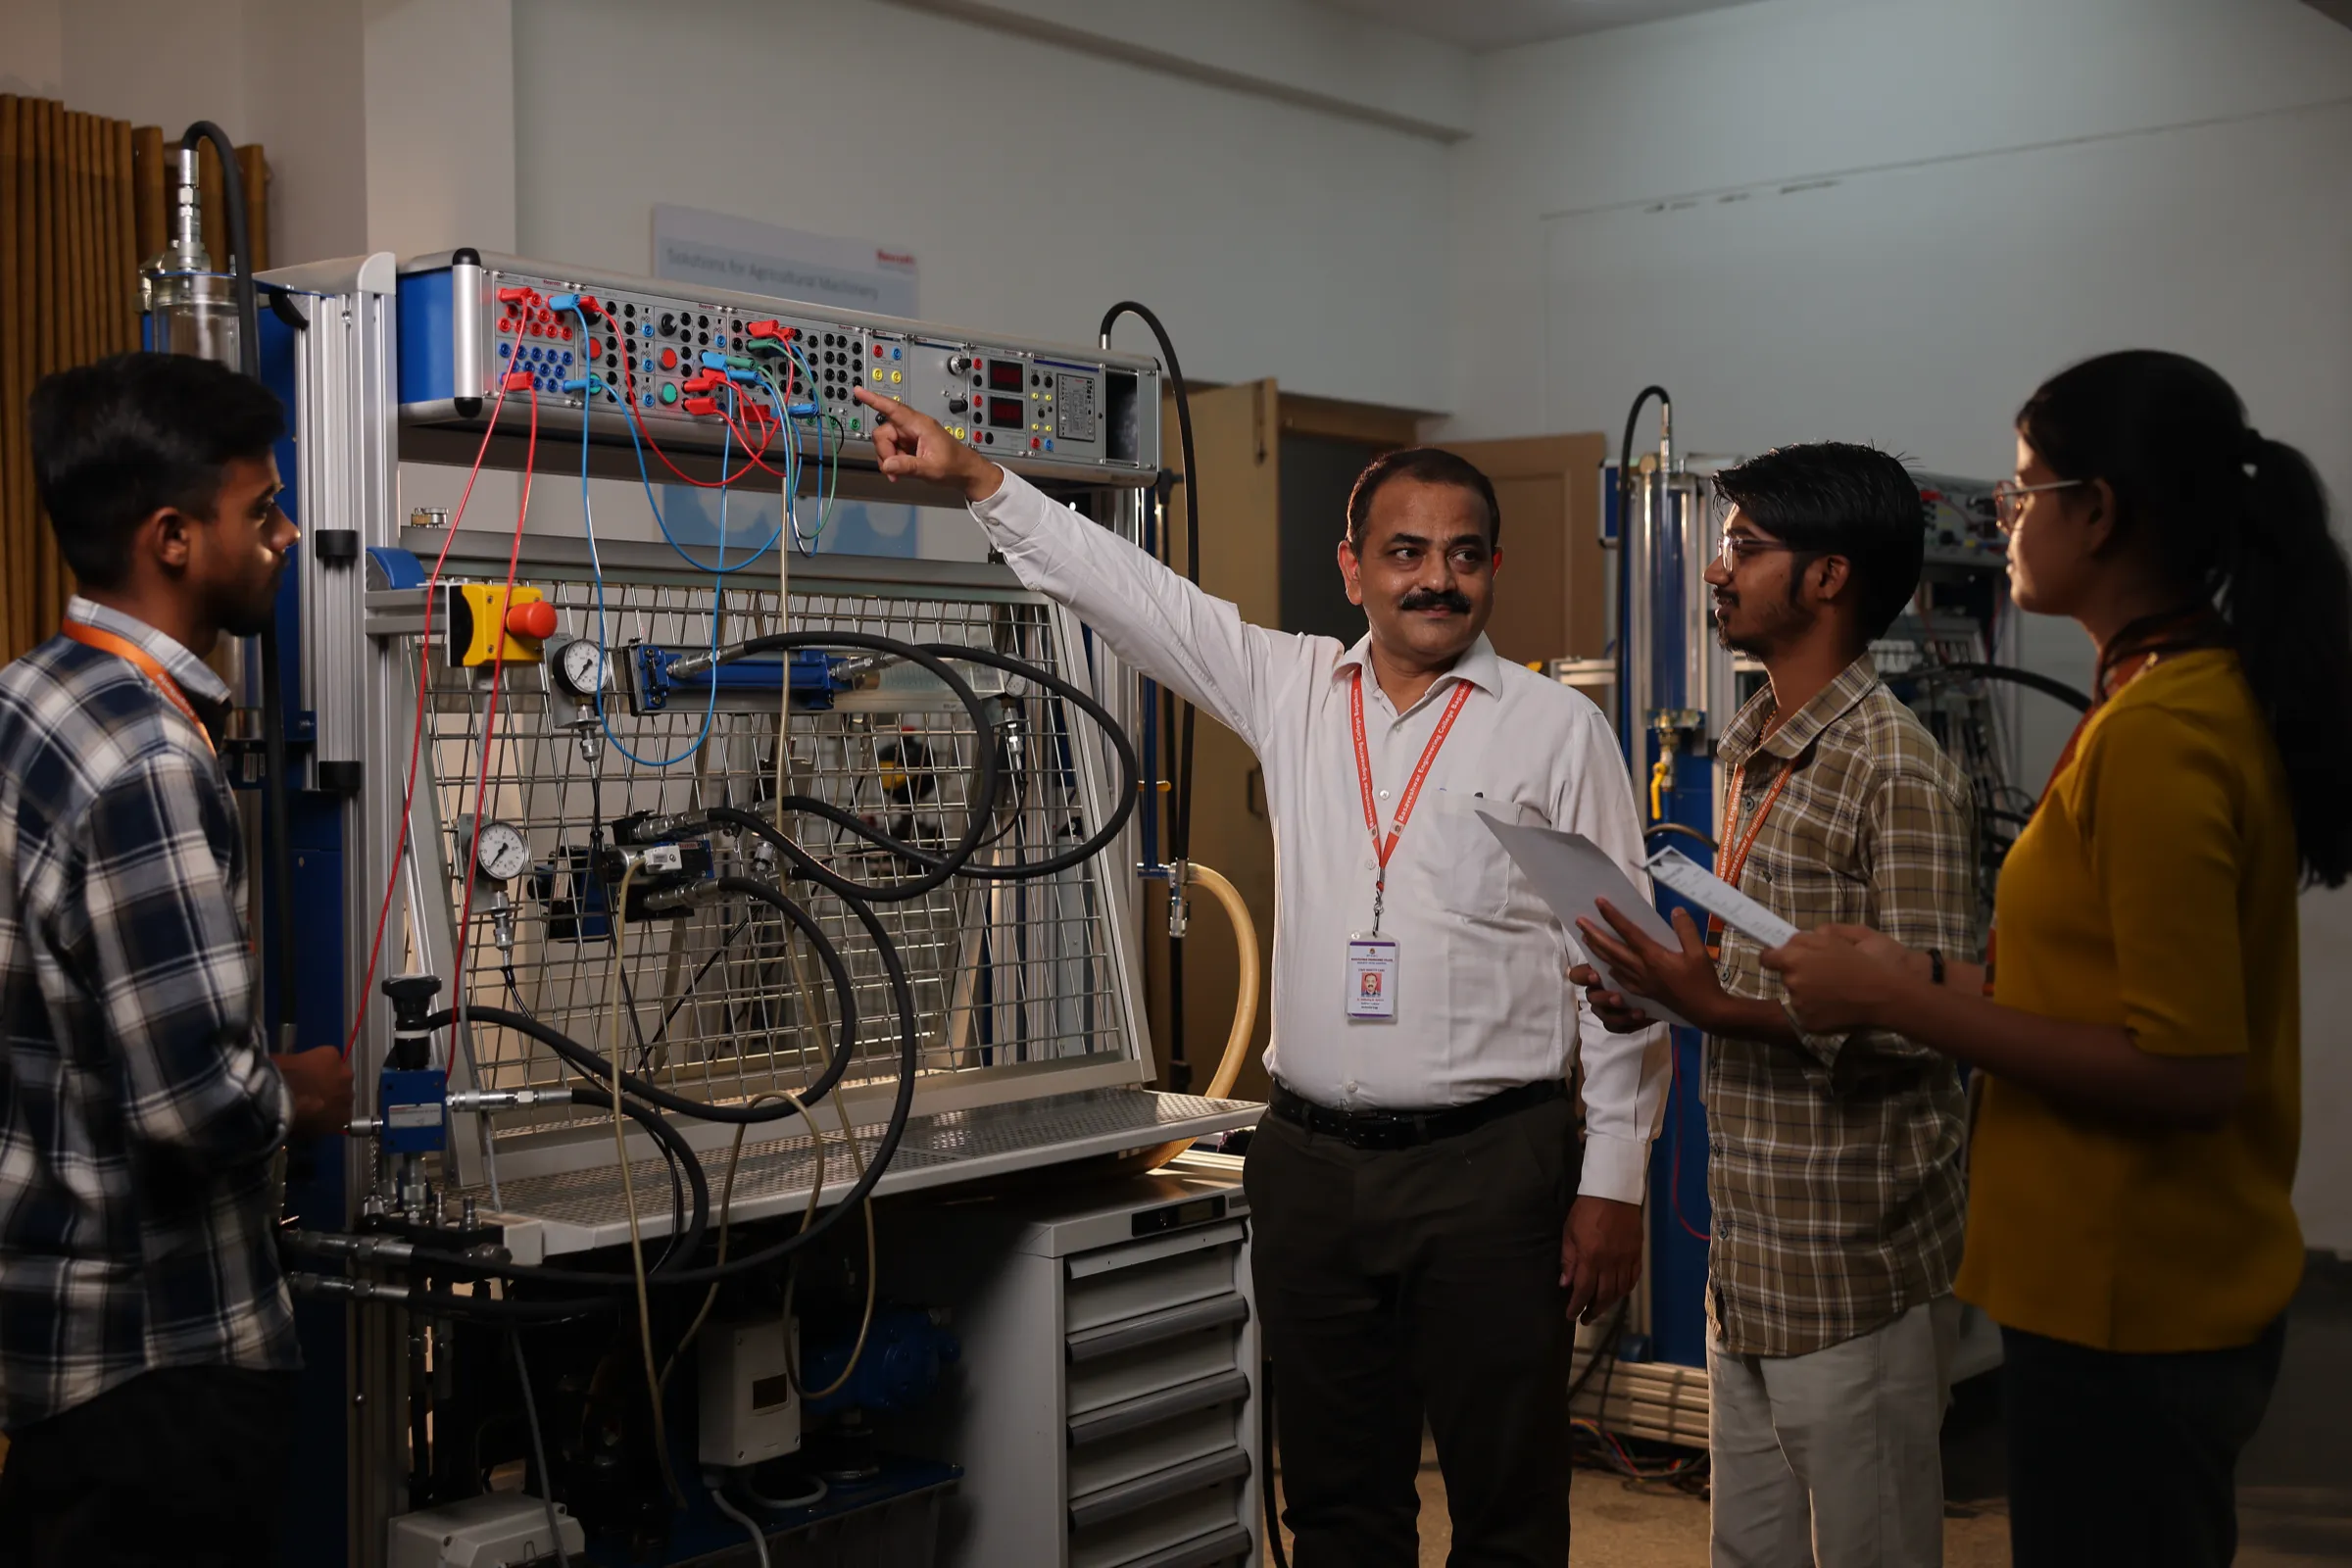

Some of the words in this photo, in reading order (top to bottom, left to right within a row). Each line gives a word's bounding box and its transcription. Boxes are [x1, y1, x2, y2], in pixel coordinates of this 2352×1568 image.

[1358, 741, 1368, 782] Engineering
[1397, 774, 1421, 821] Basaveshwar
[1417, 734, 1443, 774] Engineering
[1438, 710, 1455, 735] College
[1746, 791, 1776, 839] Engineering
[1719, 826, 1733, 880] asaveshwar
